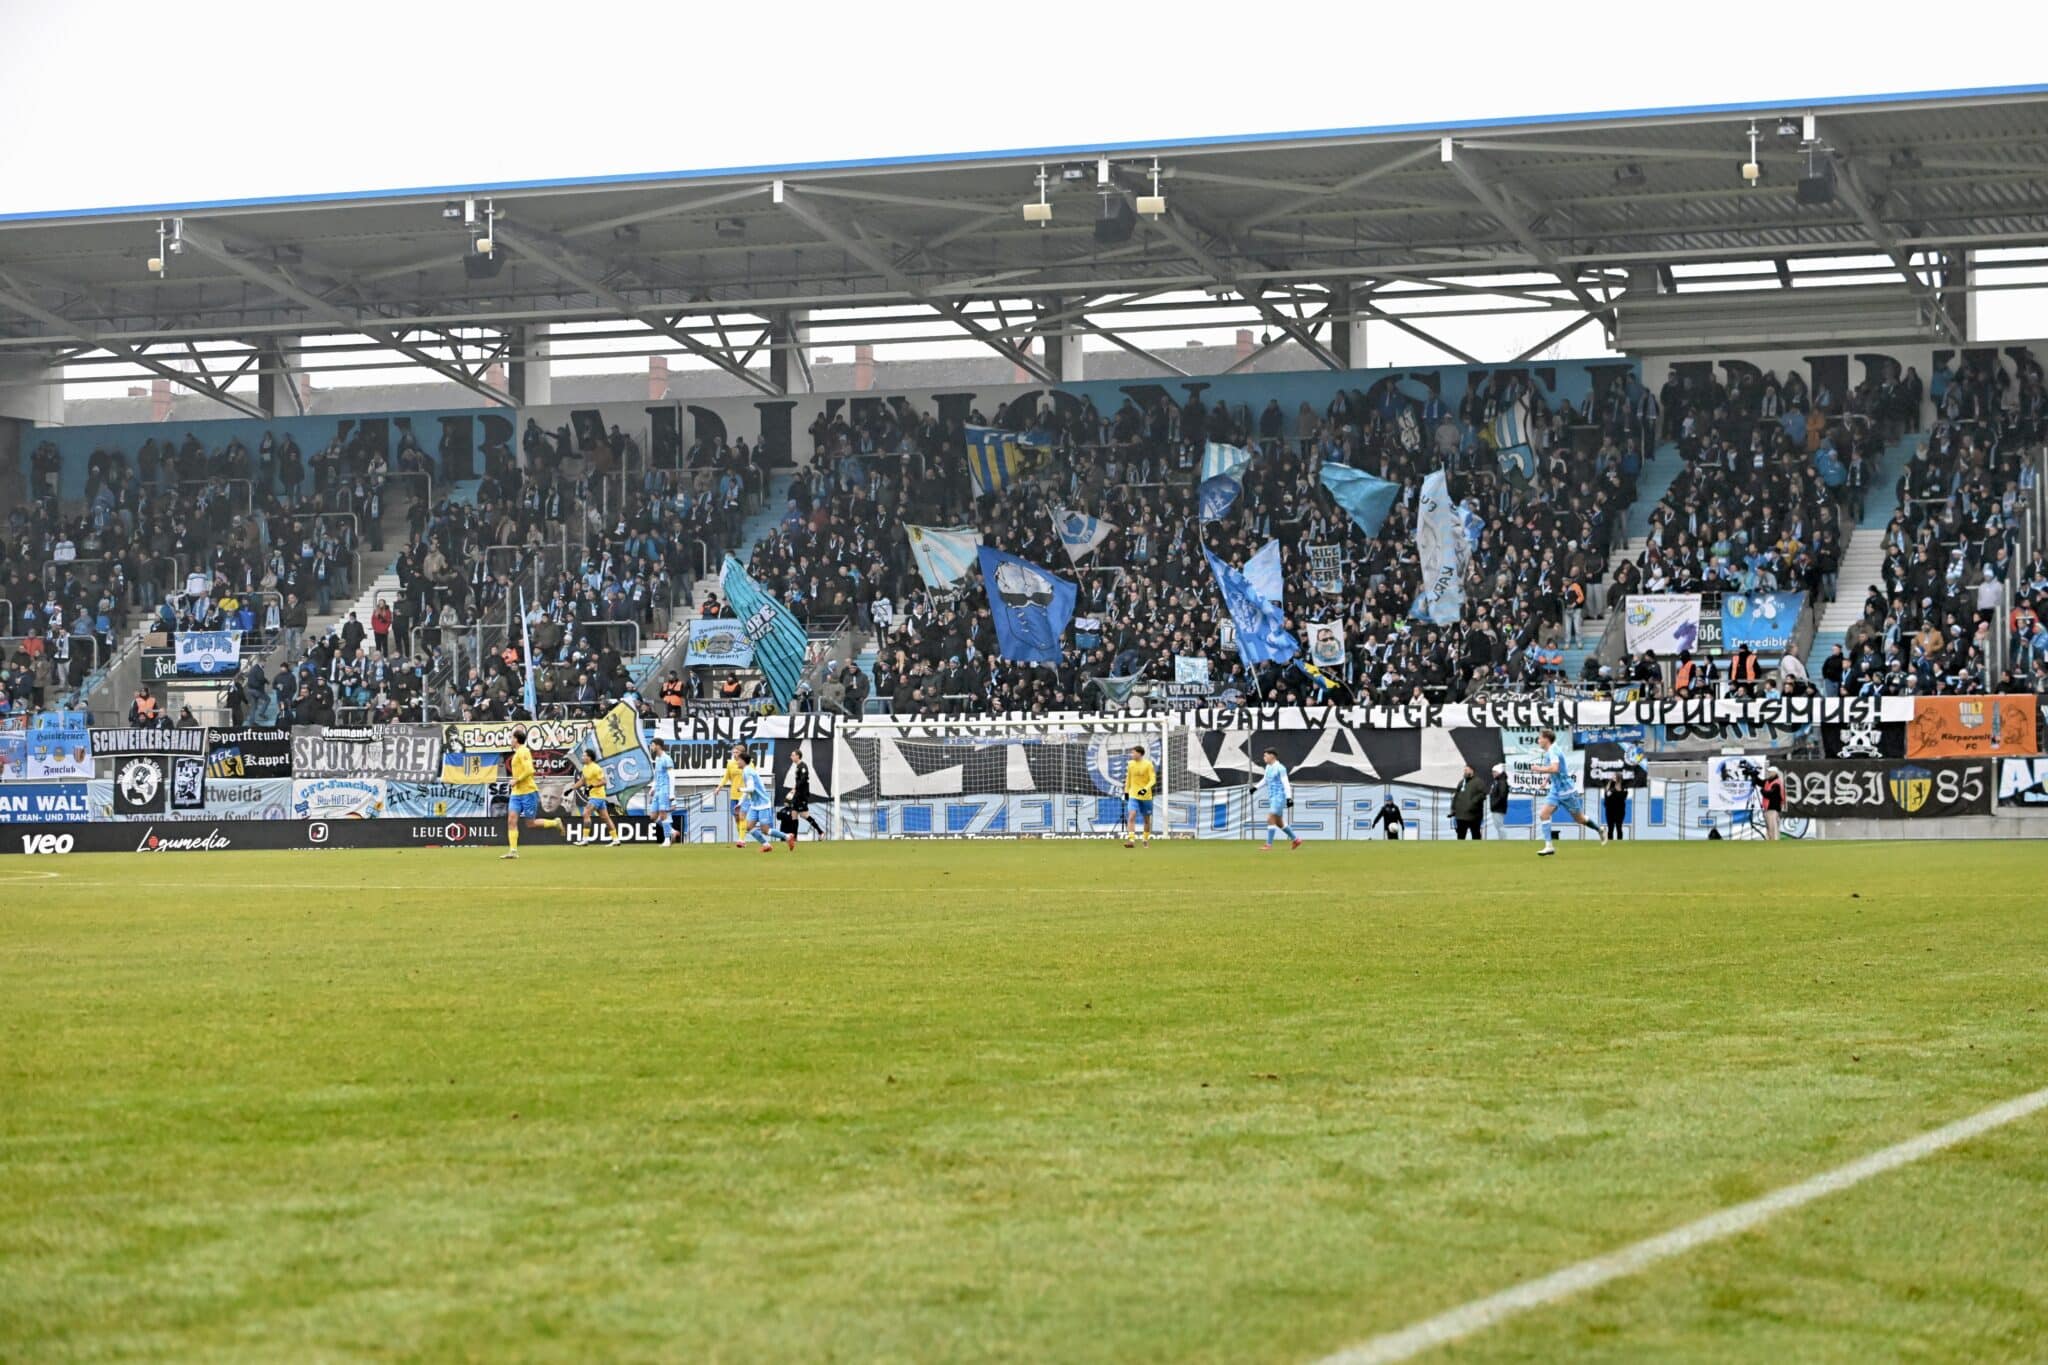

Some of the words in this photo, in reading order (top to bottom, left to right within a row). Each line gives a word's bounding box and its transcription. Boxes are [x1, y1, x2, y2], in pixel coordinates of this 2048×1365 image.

[674, 715, 758, 740] FANS
[1303, 704, 1442, 729] WEITER
[1467, 701, 1579, 729] GEGEN
[92, 728, 202, 752] SCHWEIKERSHAIN
[208, 728, 291, 744] Sportfreunde
[1965, 742, 1978, 750] FC
[243, 752, 290, 767] Kappel
[380, 737, 440, 772] FREI
[663, 743, 733, 770] GRUPPE
[1936, 766, 1984, 804] 85
[45, 812, 63, 822] UND
[412, 826, 443, 838] LEUE
[469, 826, 498, 838] NILL
[22, 833, 74, 855] veo
